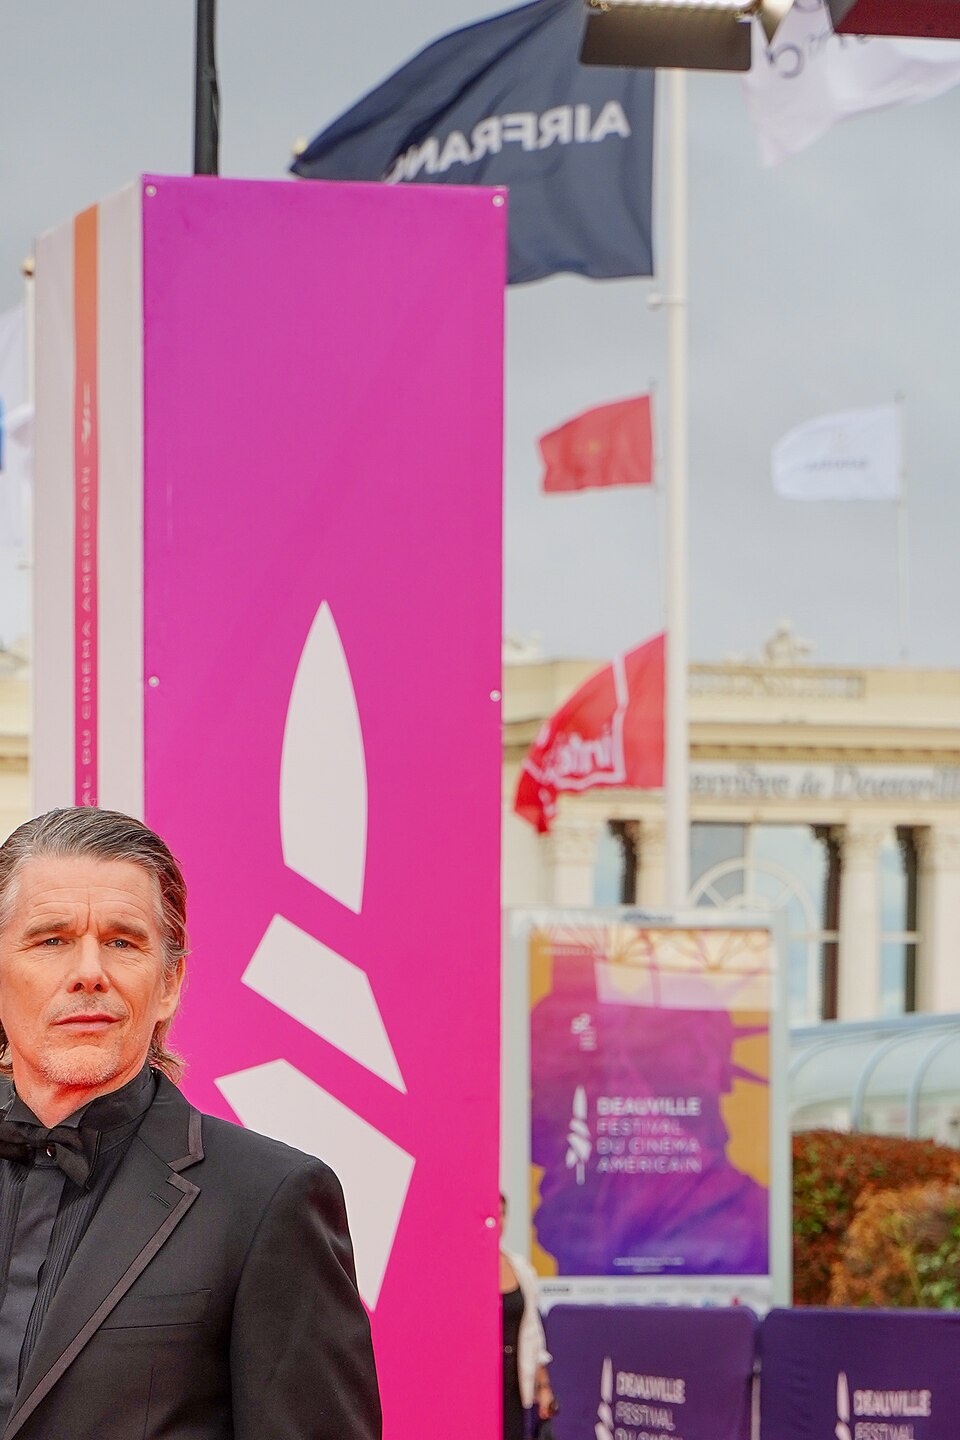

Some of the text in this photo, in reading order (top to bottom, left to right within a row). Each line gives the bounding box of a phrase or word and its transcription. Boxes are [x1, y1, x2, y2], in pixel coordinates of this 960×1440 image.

[81, 729, 92, 765] DU
[596, 1096, 702, 1116] DEAUVILLE
[596, 1118, 683, 1136] FESTIVAL
[596, 1136, 626, 1155] DU
[616, 1370, 686, 1405] DEAUVILLE
[615, 1400, 676, 1431] FESTIVAL
[853, 1389, 932, 1417] DEAUVILLE
